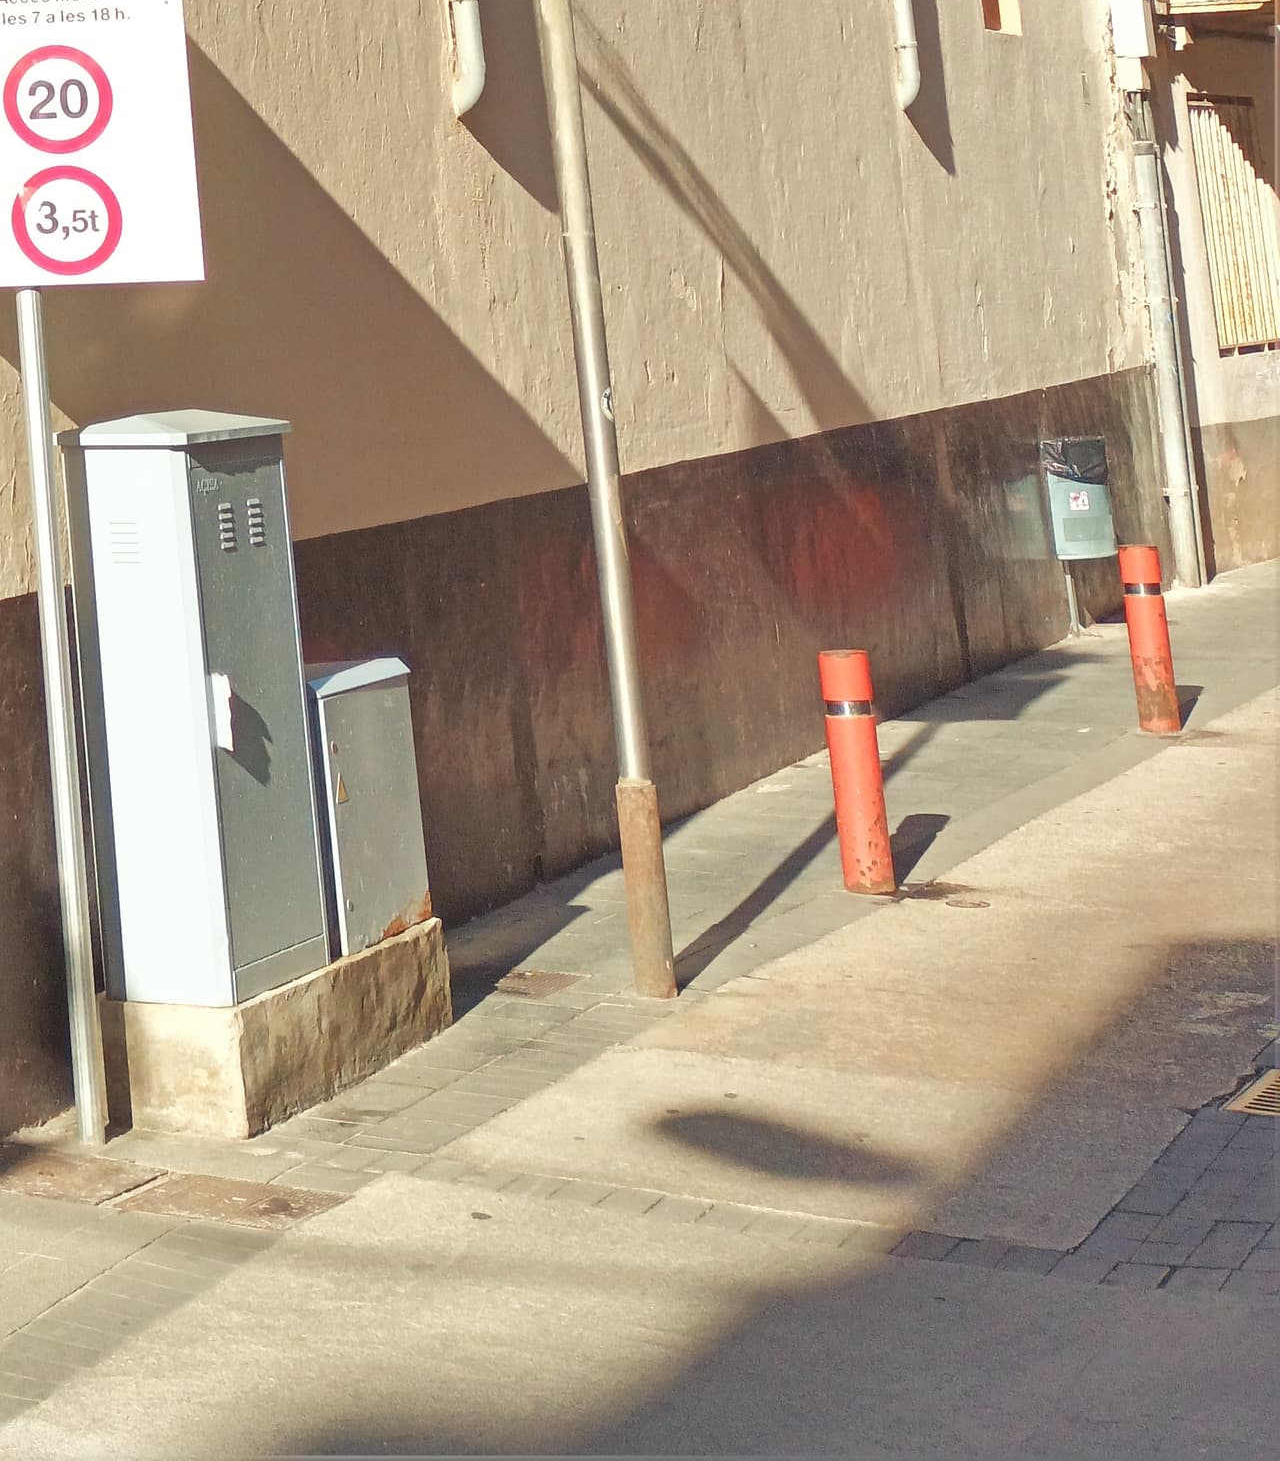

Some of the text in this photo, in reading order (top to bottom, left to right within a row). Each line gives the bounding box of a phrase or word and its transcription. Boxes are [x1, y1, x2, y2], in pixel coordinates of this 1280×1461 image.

[2, 12, 27, 25] les
[31, 11, 41, 24] 7
[46, 13, 56, 24] a
[60, 10, 86, 23] les
[91, 8, 111, 21] 18
[115, 7, 131, 21] h.
[28, 78, 89, 120] 20
[35, 201, 100, 240] 3,5t
